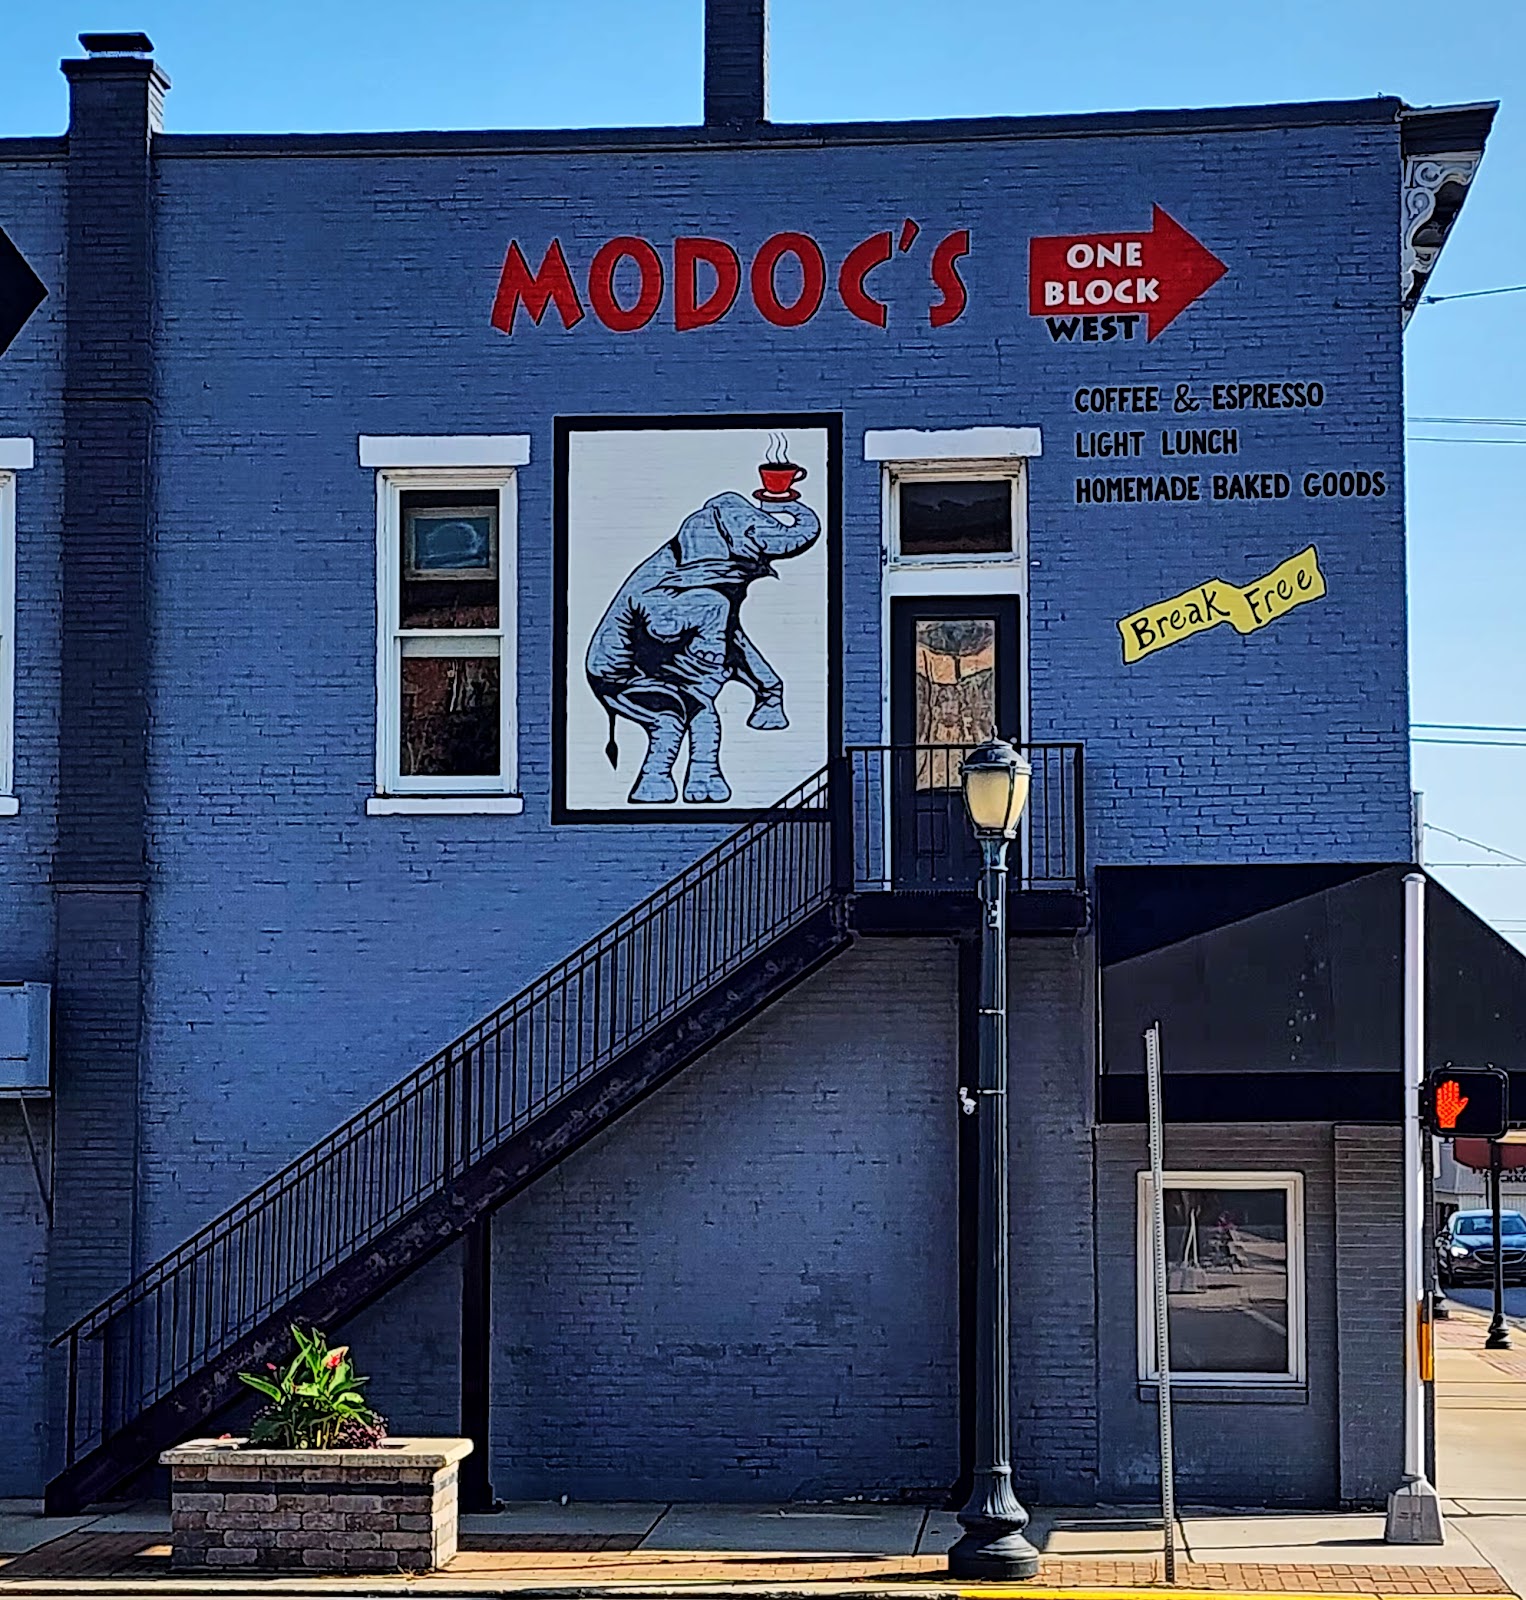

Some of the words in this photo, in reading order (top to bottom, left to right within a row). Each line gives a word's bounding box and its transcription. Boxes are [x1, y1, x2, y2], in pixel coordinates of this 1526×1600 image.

[1066, 242, 1142, 269] ONE
[491, 217, 969, 335] MODOC'S
[1044, 279, 1160, 307] BLOCK
[1045, 315, 1140, 342] WEST
[1074, 386, 1159, 413] COFFEE
[1173, 384, 1200, 412] &
[1212, 383, 1324, 410] ESPRESSO
[1076, 432, 1145, 458] LIGHT
[1162, 429, 1238, 455] LUNCH
[1076, 476, 1200, 503] HOMEMADE
[1213, 473, 1290, 499] BAKED
[1303, 471, 1386, 498] GOODS
[1244, 568, 1314, 625] Free
